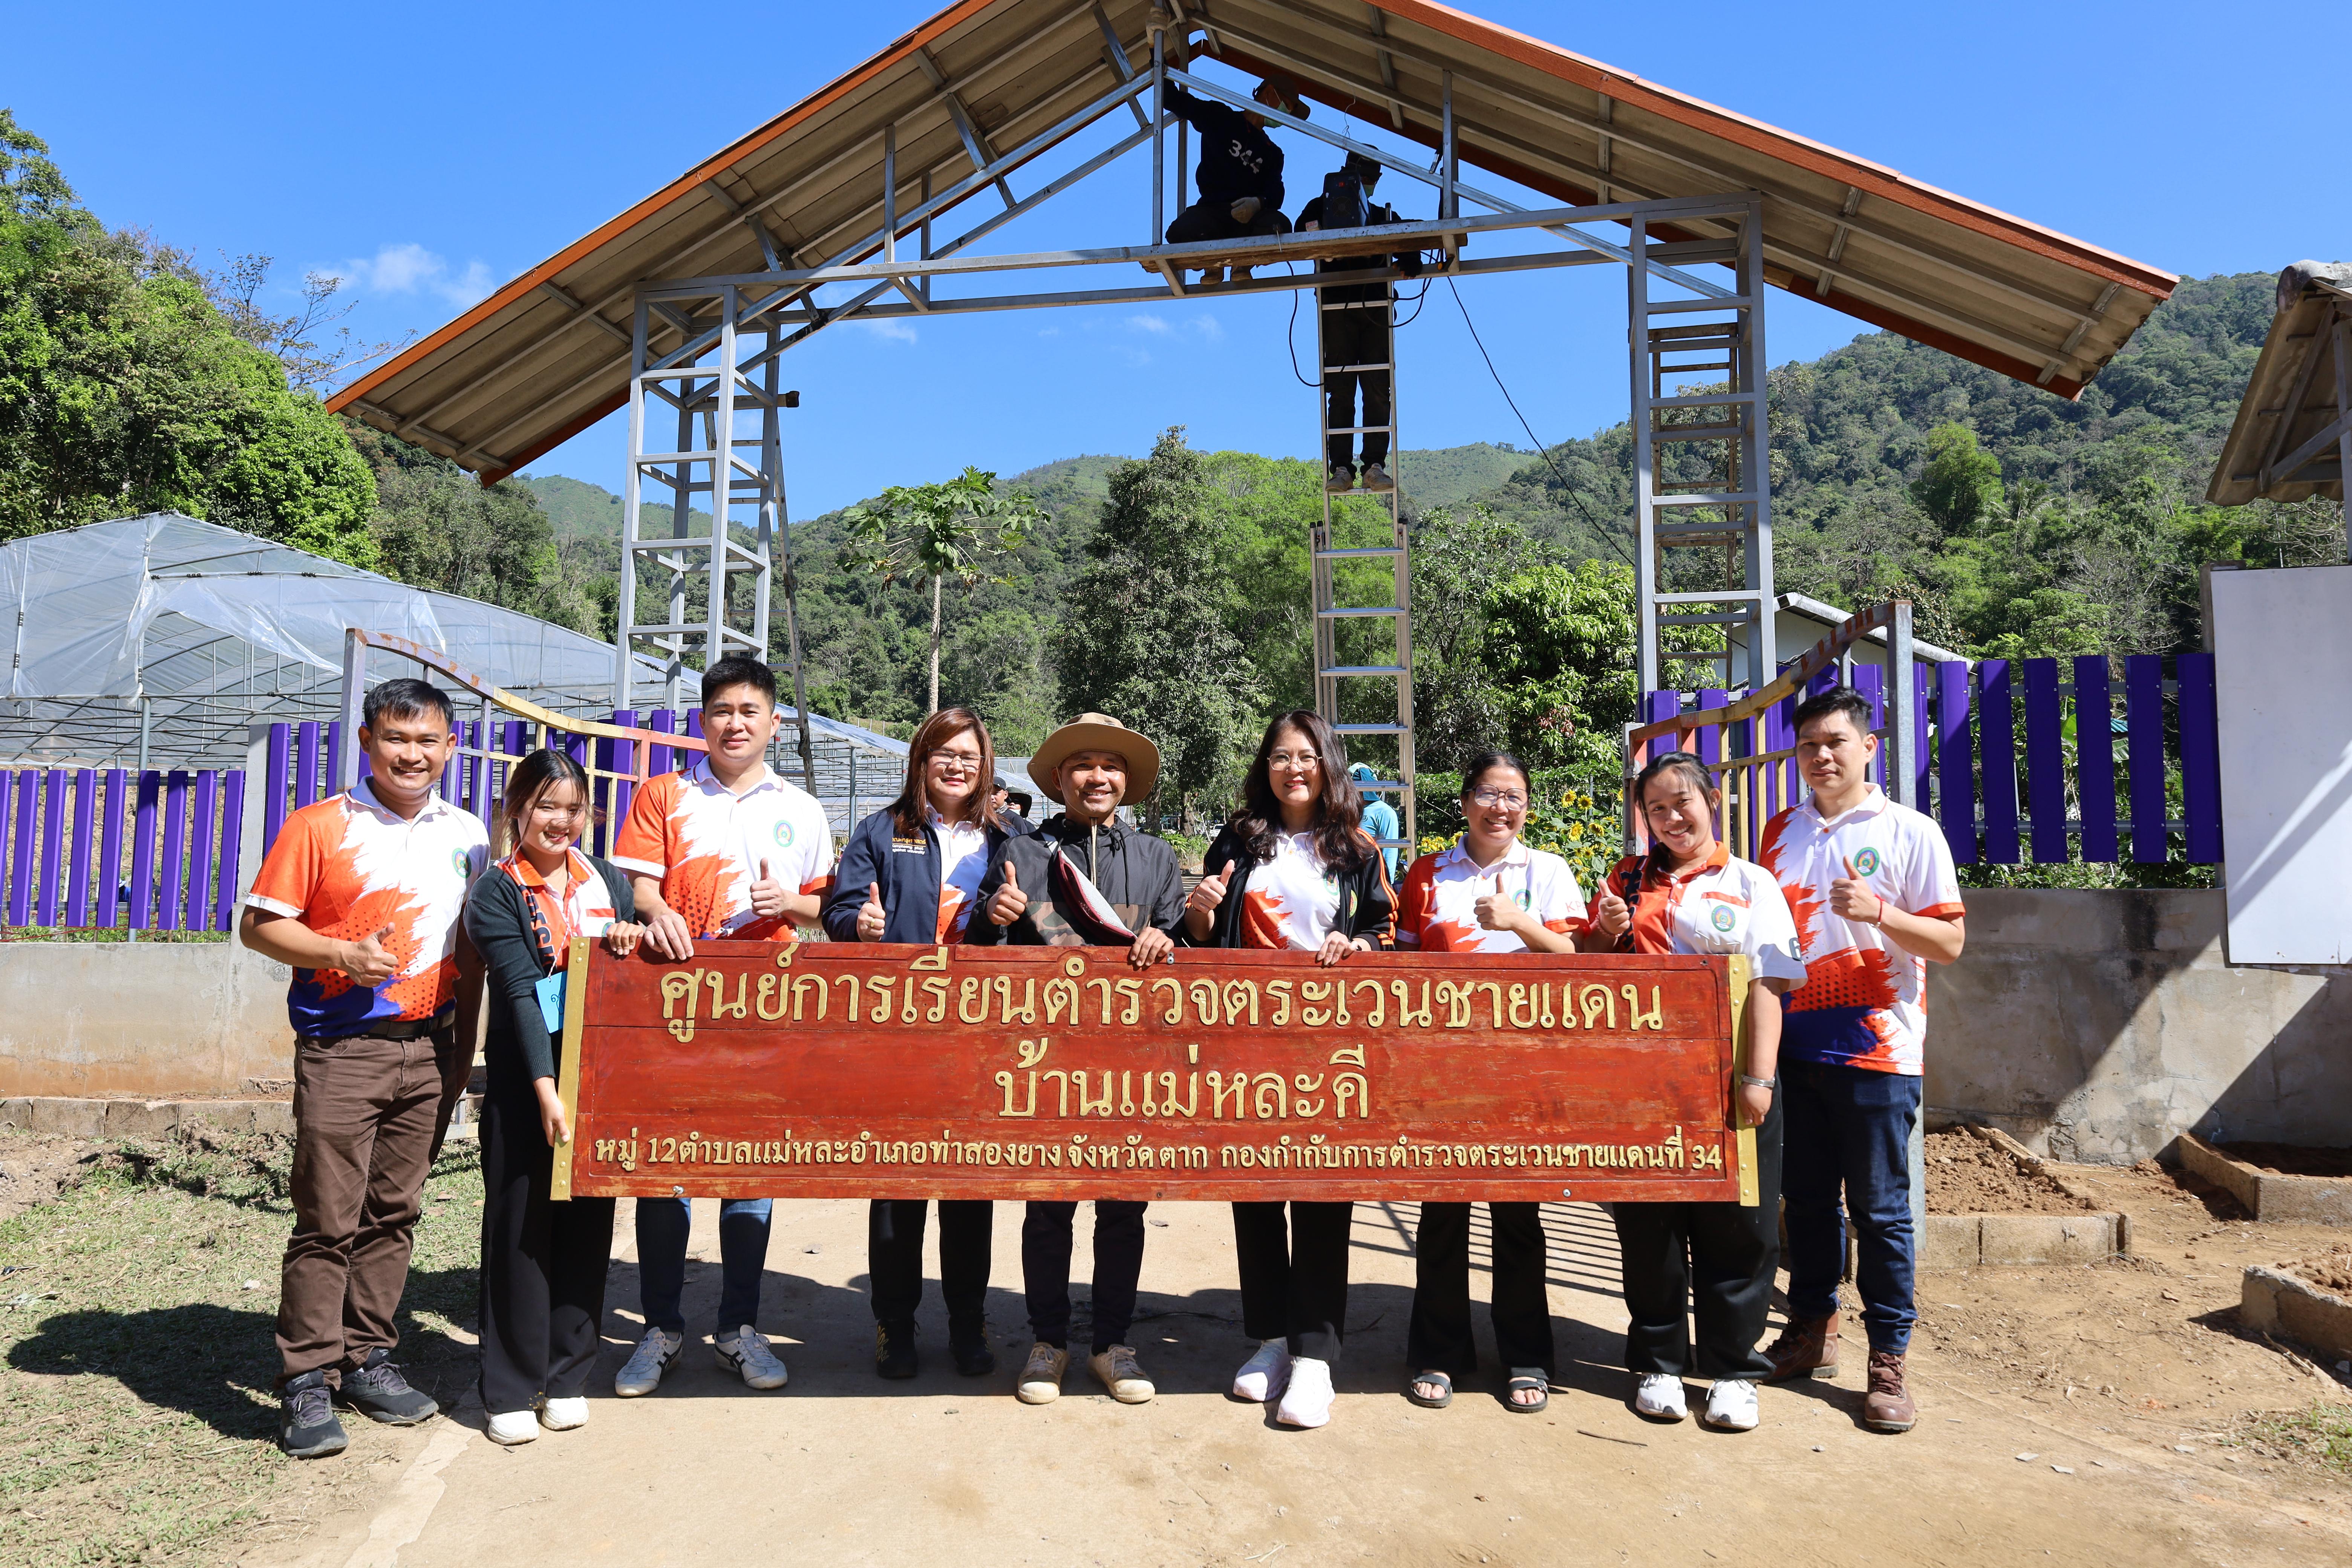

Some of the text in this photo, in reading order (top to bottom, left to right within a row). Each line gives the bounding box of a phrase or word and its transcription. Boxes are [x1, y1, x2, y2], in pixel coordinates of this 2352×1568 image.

[660, 942, 1663, 1043] ศูนย์การเรียนตำรวจตระเวนชายแดน
[994, 1037, 1368, 1119] บ้านแม่หละคี
[595, 1127, 638, 1171] หมู่
[1692, 1145, 1722, 1170] 34
